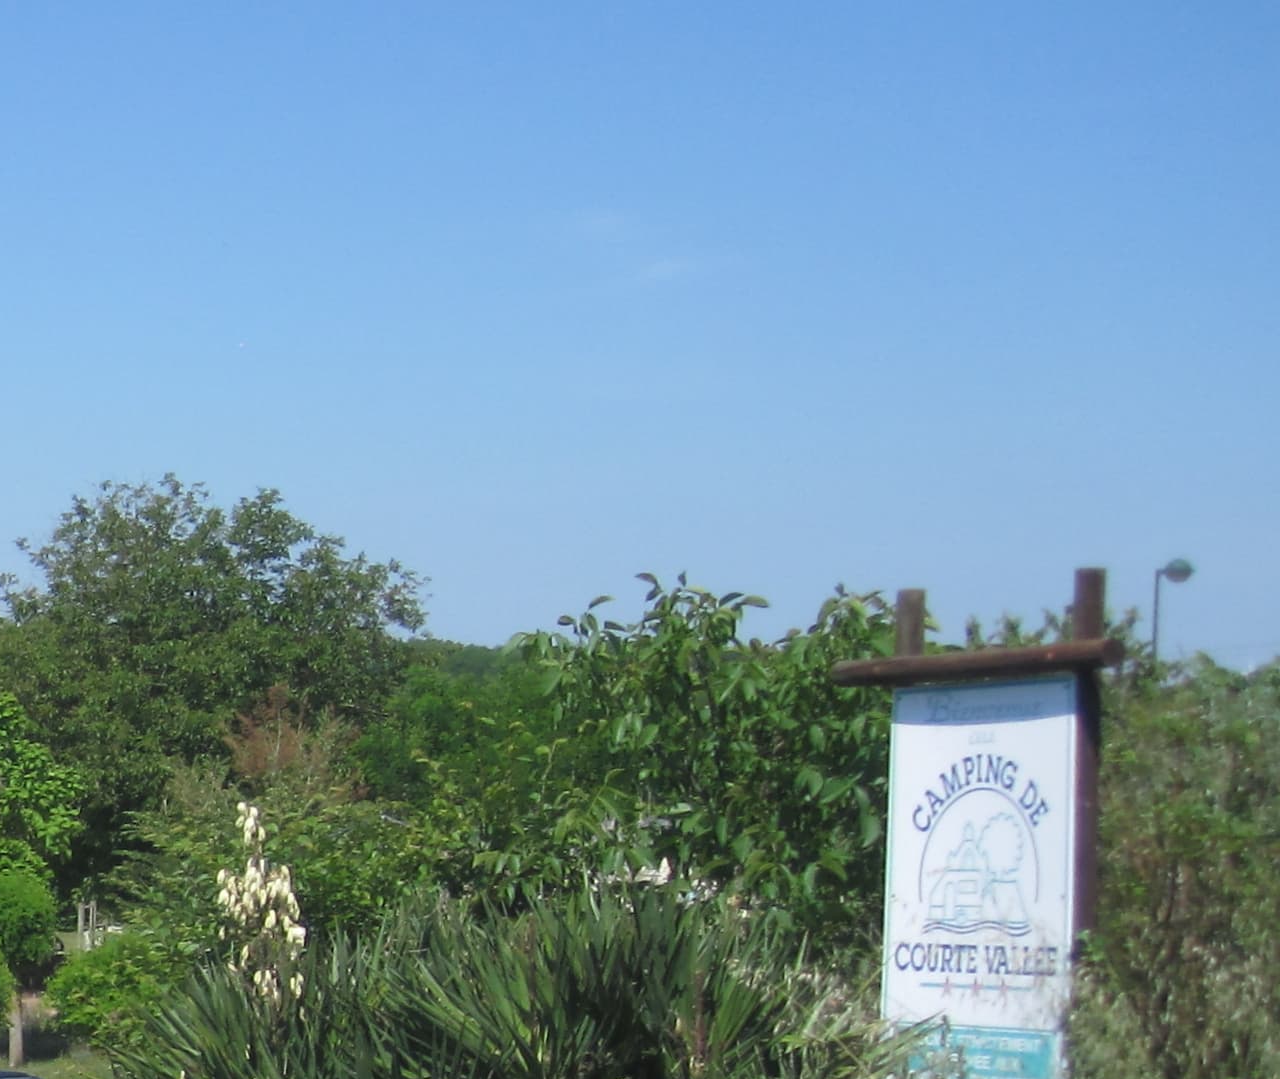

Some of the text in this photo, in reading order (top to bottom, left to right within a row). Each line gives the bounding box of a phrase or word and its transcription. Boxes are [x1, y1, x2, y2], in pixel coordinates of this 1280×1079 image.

[912, 753, 1049, 832] CAMPING DE
[894, 941, 977, 974] COURTE
